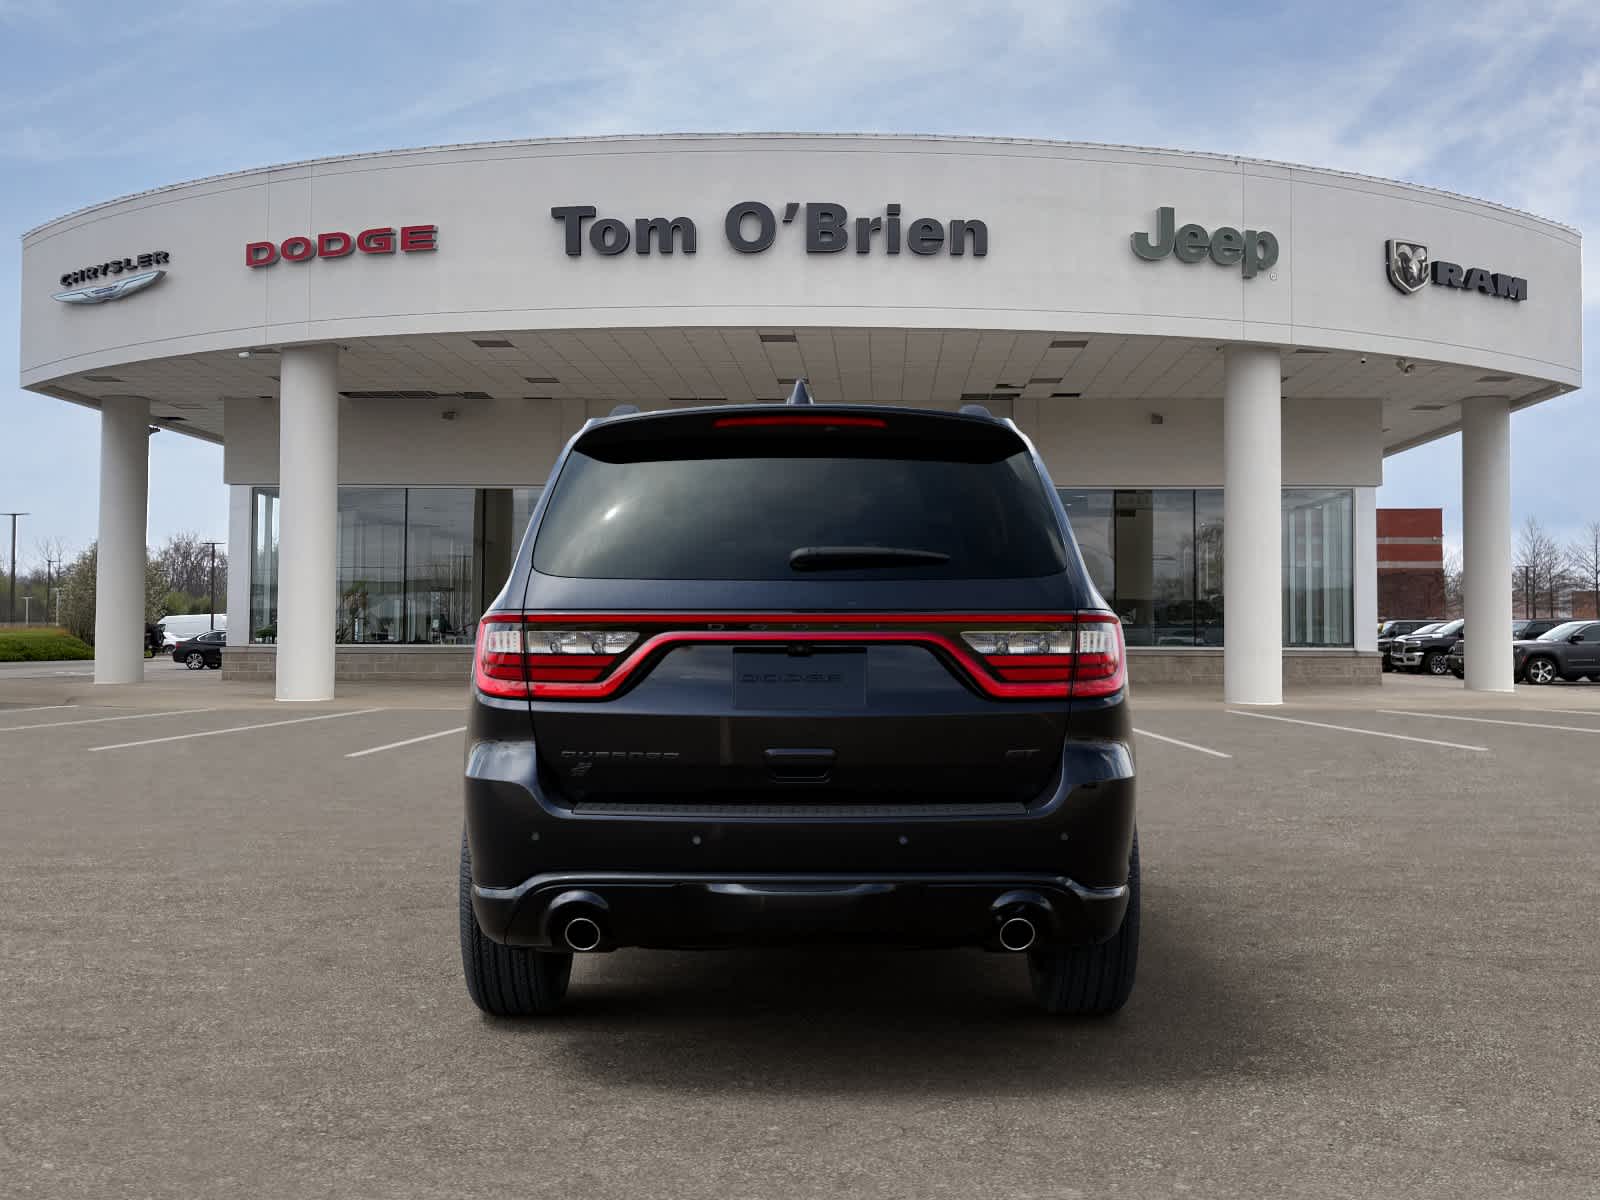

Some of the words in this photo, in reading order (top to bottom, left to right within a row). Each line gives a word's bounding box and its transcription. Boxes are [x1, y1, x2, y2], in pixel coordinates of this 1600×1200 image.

[245, 224, 438, 270] DODGE
[550, 205, 697, 257] Tom
[1130, 206, 1280, 280] Jeep
[60, 250, 170, 287] CHRYSLER
[1431, 260, 1528, 302] RAM
